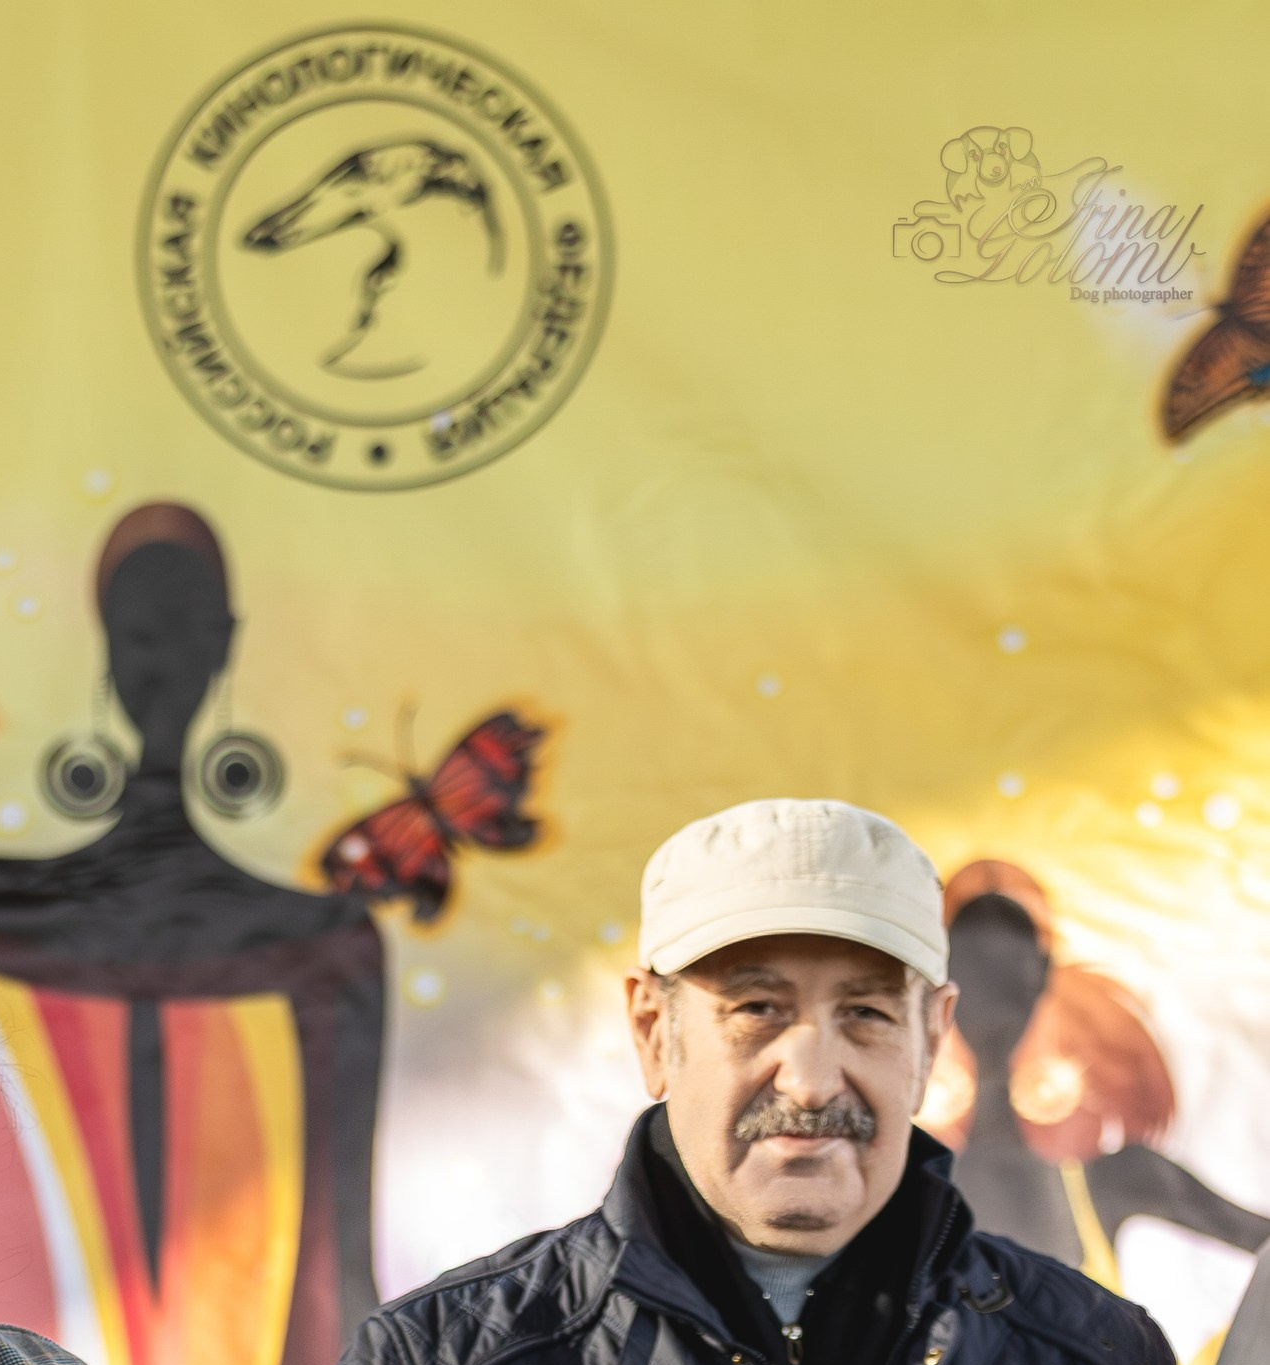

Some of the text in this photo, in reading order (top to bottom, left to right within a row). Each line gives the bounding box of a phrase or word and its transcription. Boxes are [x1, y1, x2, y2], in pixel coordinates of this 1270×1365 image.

[160, 42, 587, 467] РОССИЙСКАЯ КИНОЛОГИЧЕСКАЯ ФЕДЕРАЦИЯ
